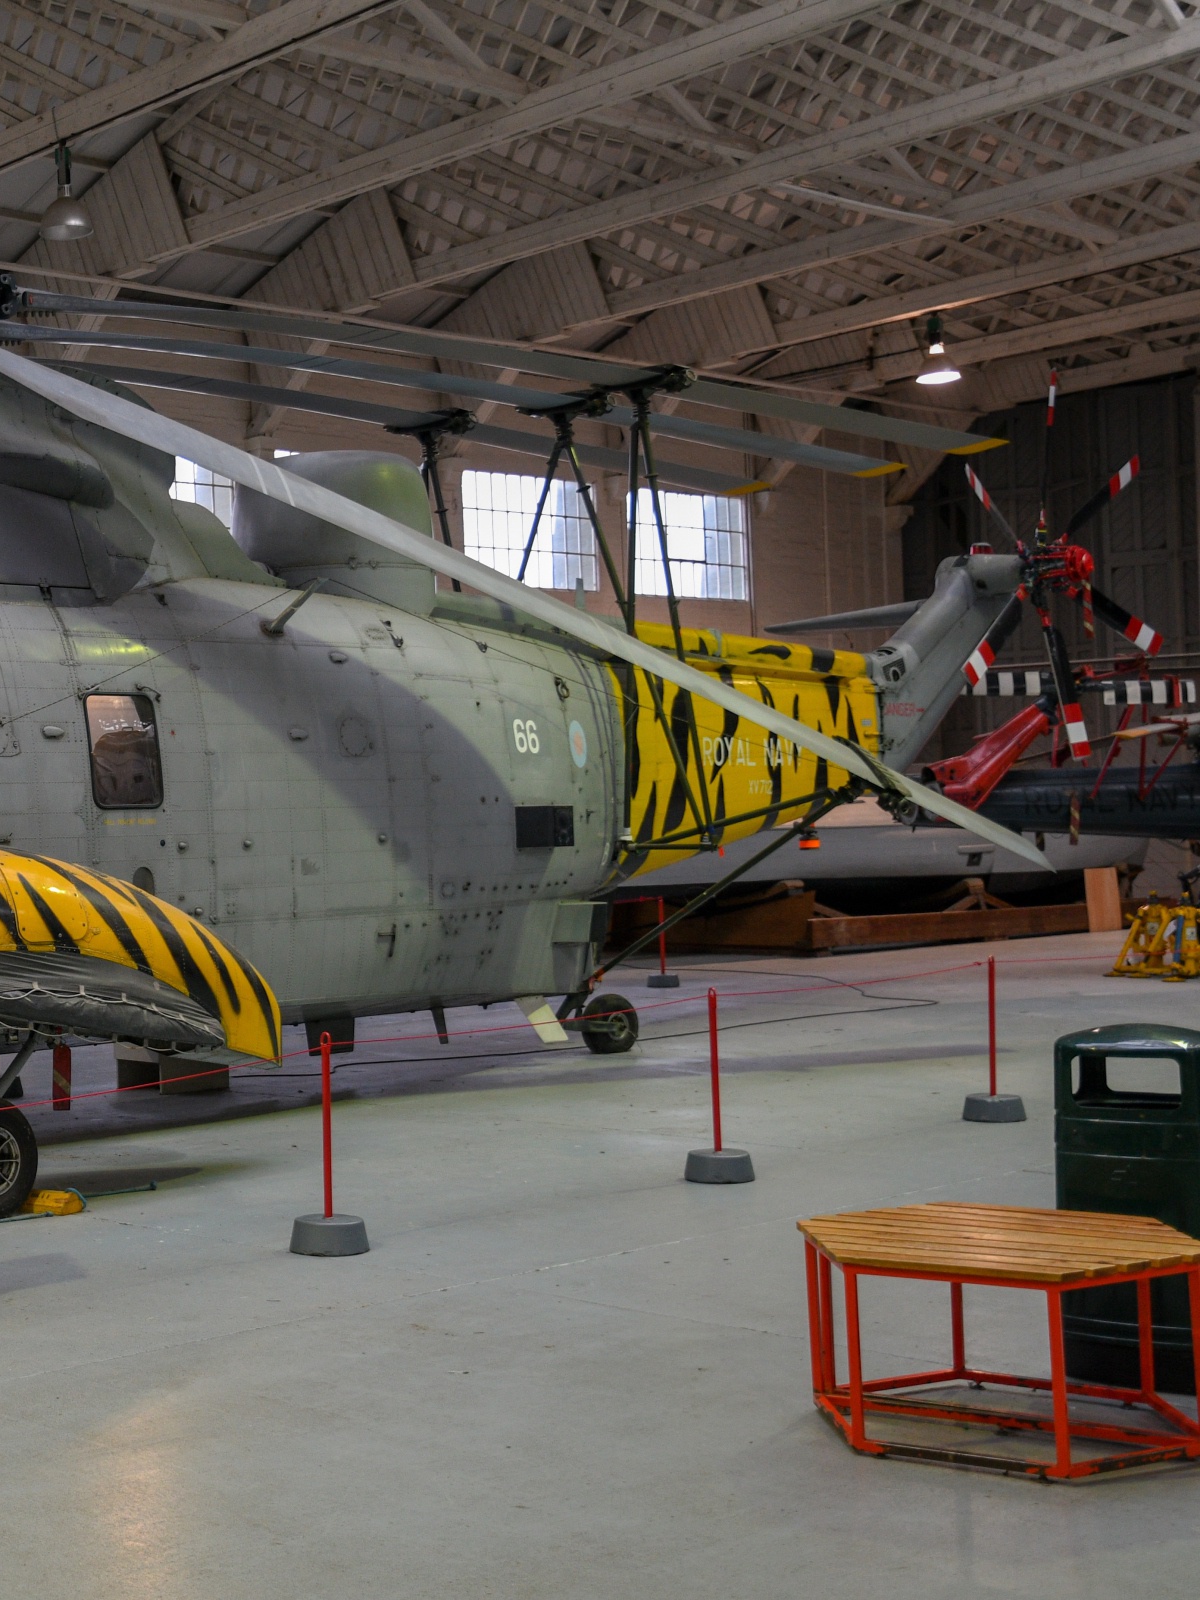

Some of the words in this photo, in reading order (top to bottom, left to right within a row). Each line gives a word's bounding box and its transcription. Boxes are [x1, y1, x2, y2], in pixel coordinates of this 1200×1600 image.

[512, 718, 540, 754] 66
[702, 736, 757, 766] ROYAL
[763, 738, 803, 767] NAVY
